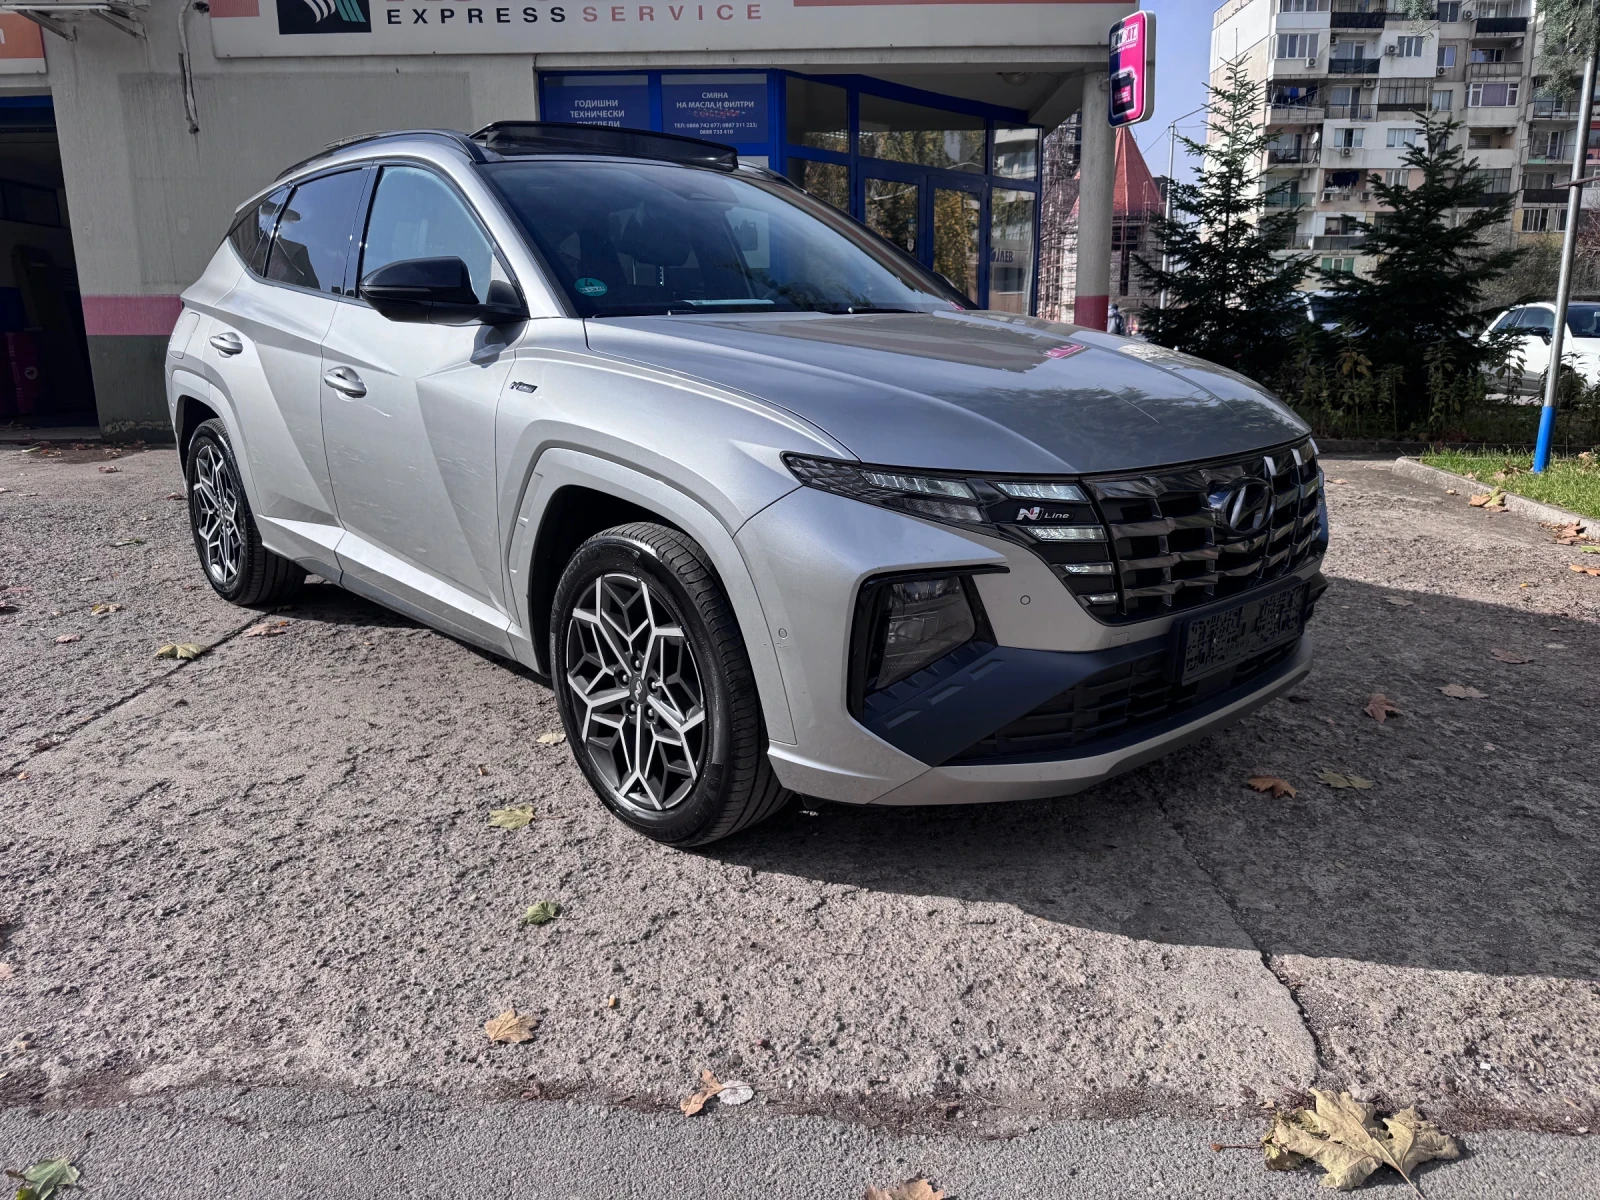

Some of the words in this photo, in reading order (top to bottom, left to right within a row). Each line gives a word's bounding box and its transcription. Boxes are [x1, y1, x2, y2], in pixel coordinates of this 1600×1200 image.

[386, 7, 566, 24] EXPRESS
[582, 4, 762, 22] SERVICE
[574, 99, 619, 109] ГОДИШНИ
[676, 101, 687, 109] НА
[688, 101, 715, 109] МАСЛА
[723, 100, 755, 108] ФИЛТРИ
[569, 110, 625, 118] ТЕХНИЧЕСКИ
